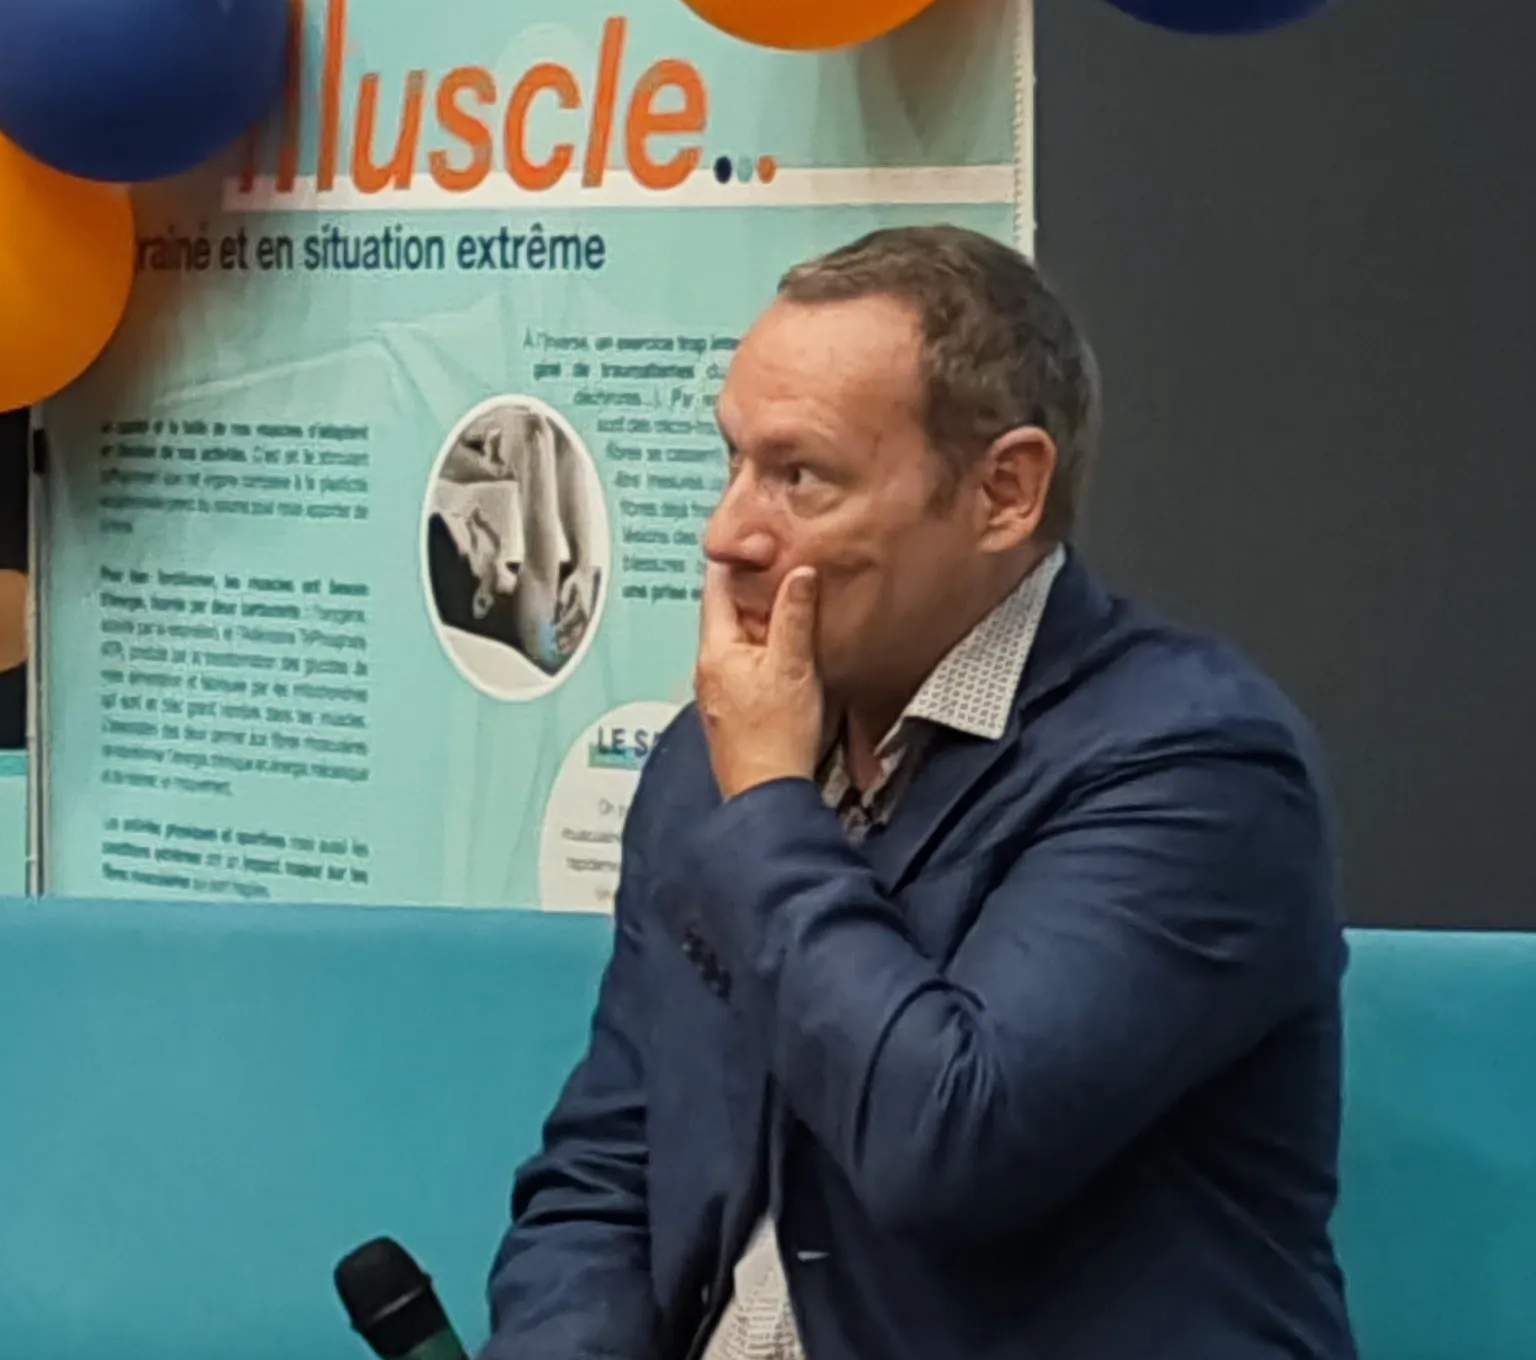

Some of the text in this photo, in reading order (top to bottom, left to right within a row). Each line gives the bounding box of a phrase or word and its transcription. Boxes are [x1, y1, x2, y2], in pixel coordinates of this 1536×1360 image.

[220, 227, 248, 271] et
[256, 232, 294, 271] en
[303, 223, 447, 271] situation
[456, 222, 607, 271] extrême
[598, 726, 626, 755] LE
